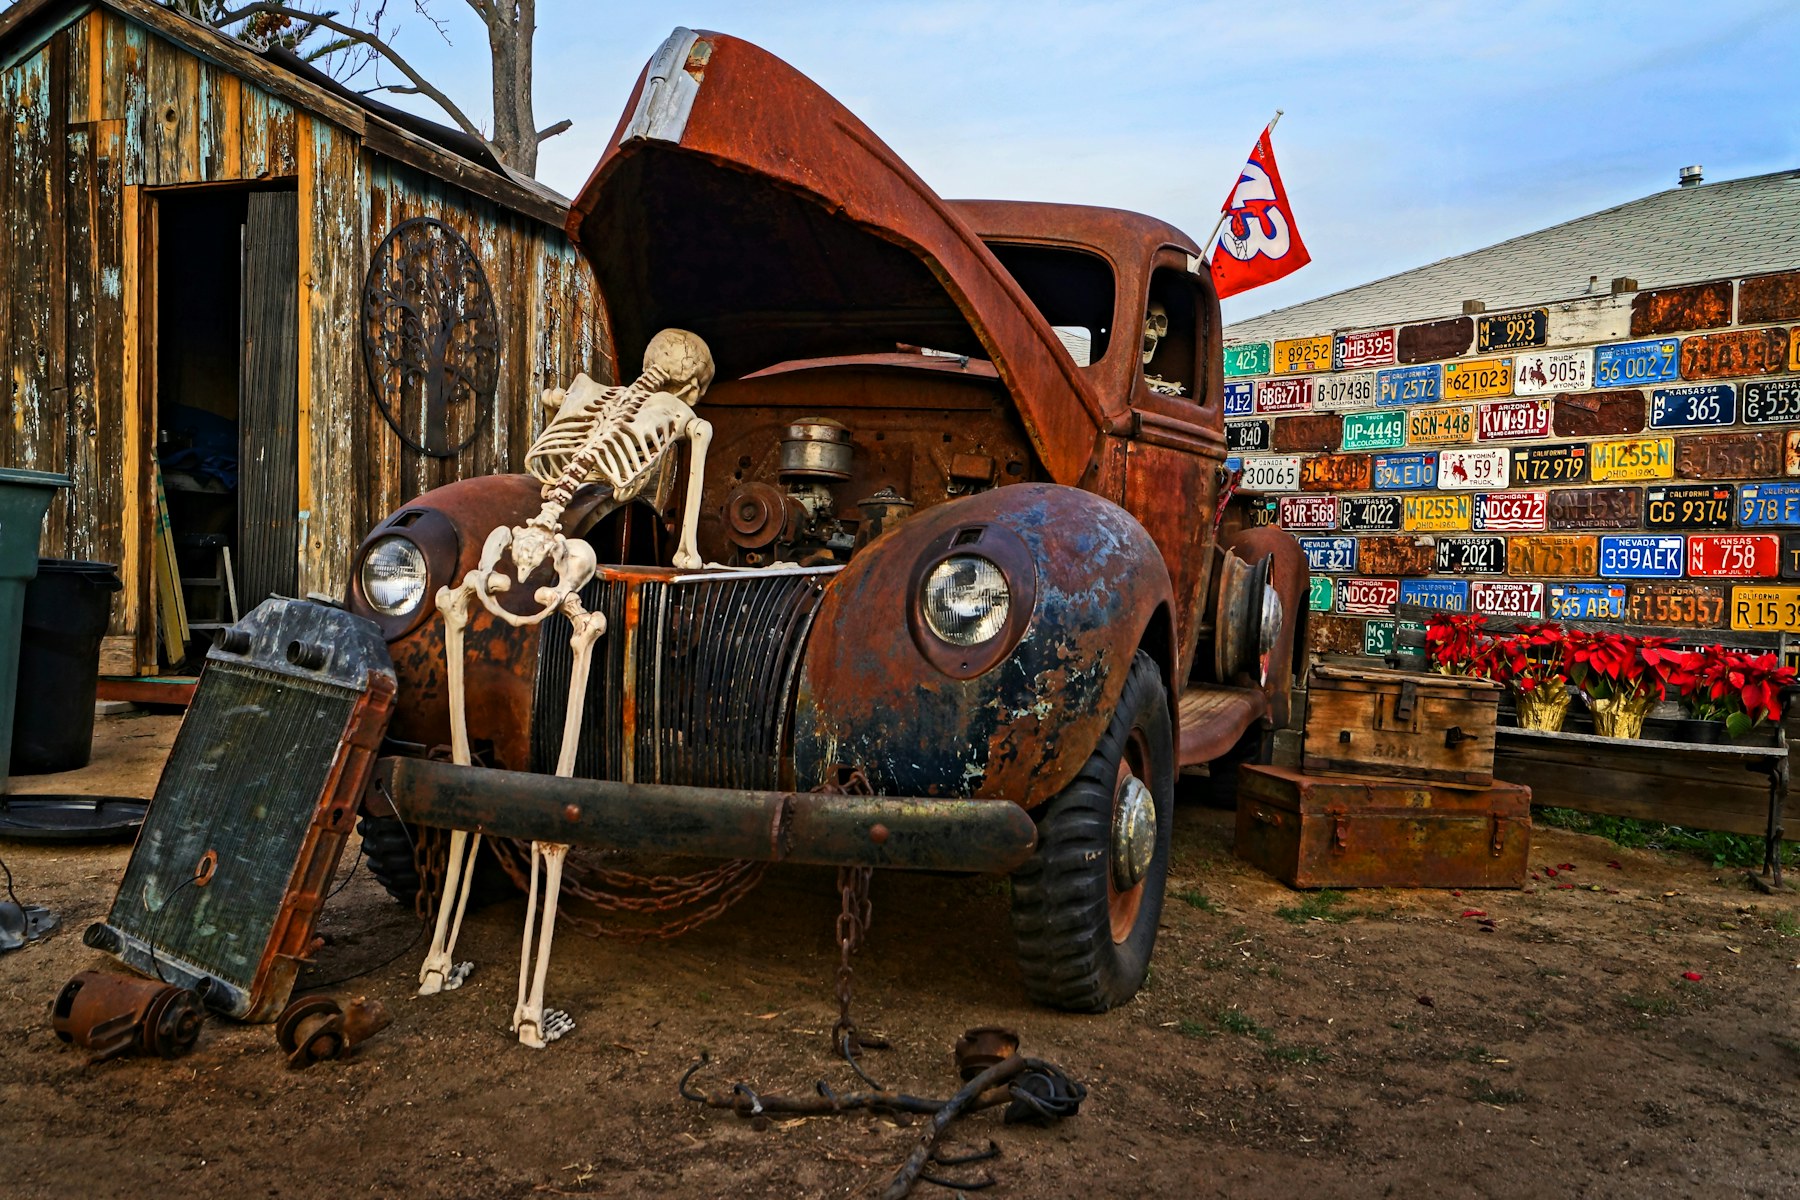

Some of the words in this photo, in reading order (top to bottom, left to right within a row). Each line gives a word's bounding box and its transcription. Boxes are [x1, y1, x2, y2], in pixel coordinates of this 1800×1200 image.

[1348, 332, 1380, 340] MICHIGAN
[1506, 319, 1536, 343] 993
[1288, 344, 1328, 362] 89252
[1340, 337, 1392, 359] DHB395
[1615, 346, 1659, 356] CALIFORNIA
[1236, 350, 1258, 370] 425
[1600, 360, 1621, 381] 56
[1625, 356, 1657, 378] 002
[1661, 353, 1674, 376] Z
[1518, 365, 1527, 385] 4
[1550, 361, 1578, 382] 905
[1272, 379, 1298, 387] ARIZONA
[1318, 381, 1370, 402] B-07436
[1381, 382, 1398, 401] PV
[1402, 378, 1435, 400] 2572
[1669, 387, 1705, 396] KANSAS
[1764, 381, 1800, 391] KANSA
[1224, 394, 1250, 412] 412
[1424, 408, 1449, 416] ARIZONA
[1498, 403, 1531, 411] ARIZONA
[1686, 396, 1720, 421] 365
[1412, 413, 1470, 436] SCN-448
[1240, 427, 1262, 446] 840
[1356, 439, 1391, 447] COLORADO
[1532, 448, 1568, 457] CALIFORNIA
[1258, 459, 1283, 467] CANADA
[1474, 459, 1491, 479] 59
[1246, 467, 1295, 485] 30065
[1377, 466, 1401, 486] 394
[1607, 470, 1628, 478] OHIO
[1669, 490, 1710, 498] CALIFORNIA
[1283, 503, 1335, 523] 3VR-568
[1361, 503, 1394, 525] 4022
[1480, 500, 1544, 519] NDC672
[1649, 500, 1676, 523] CG
[1682, 500, 1728, 522] 9374
[1742, 498, 1779, 521] 978
[1416, 521, 1433, 529] OHIO
[1618, 539, 1656, 547] NEVADA
[1461, 544, 1494, 566] 2021
[1605, 549, 1679, 570] 339AEK
[1720, 545, 1756, 570] 758
[1342, 586, 1396, 604] NDC672
[1738, 592, 1780, 600] CALIFORNIA
[1551, 596, 1581, 618] 965
[1586, 597, 1622, 618] ABJ
[1642, 595, 1724, 623] 155357
[1737, 601, 1750, 625] R
[1755, 601, 1778, 625] 15
[1784, 602, 1800, 627] 3
